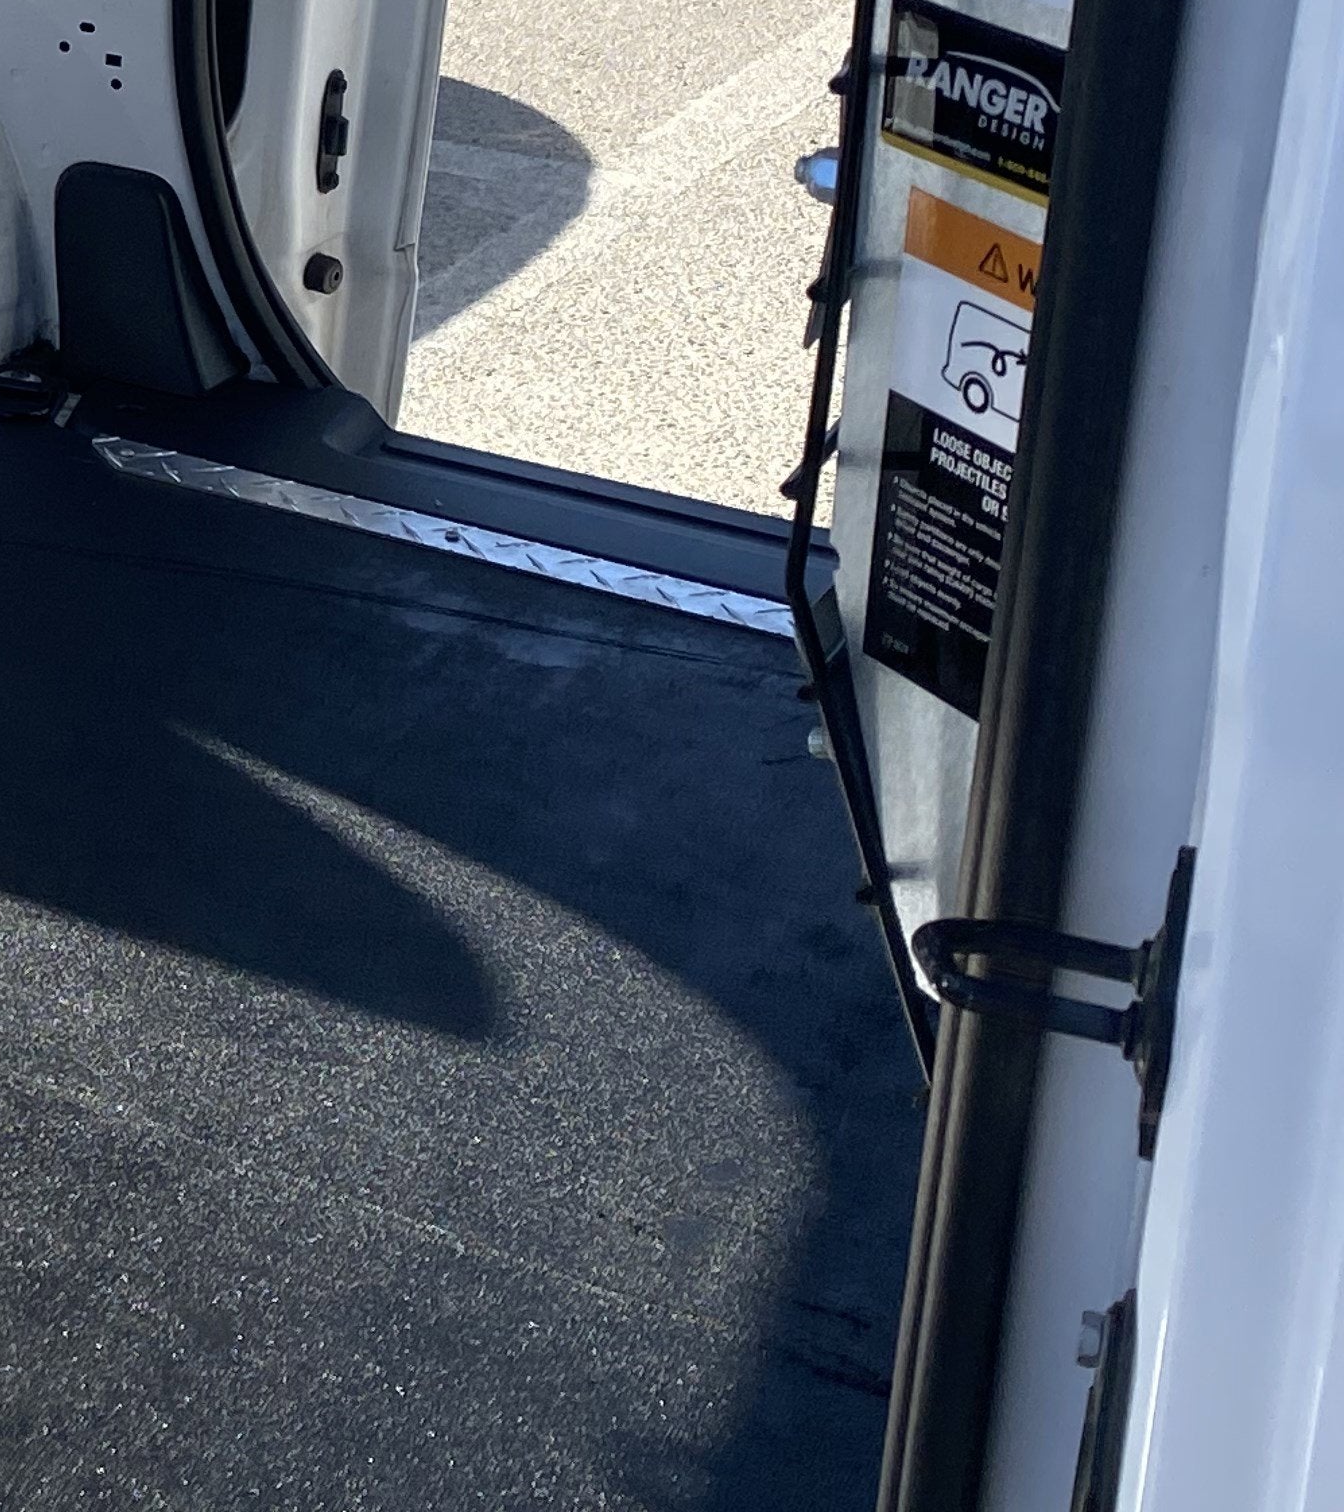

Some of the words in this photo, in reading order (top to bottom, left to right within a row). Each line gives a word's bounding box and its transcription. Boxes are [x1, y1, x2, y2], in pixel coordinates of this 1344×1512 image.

[905, 49, 1048, 134] RANGER
[977, 113, 1046, 152] DESIGN
[933, 427, 972, 461] LOOSE
[929, 446, 1008, 501] PROJECTILES
[981, 494, 1000, 518] OR
